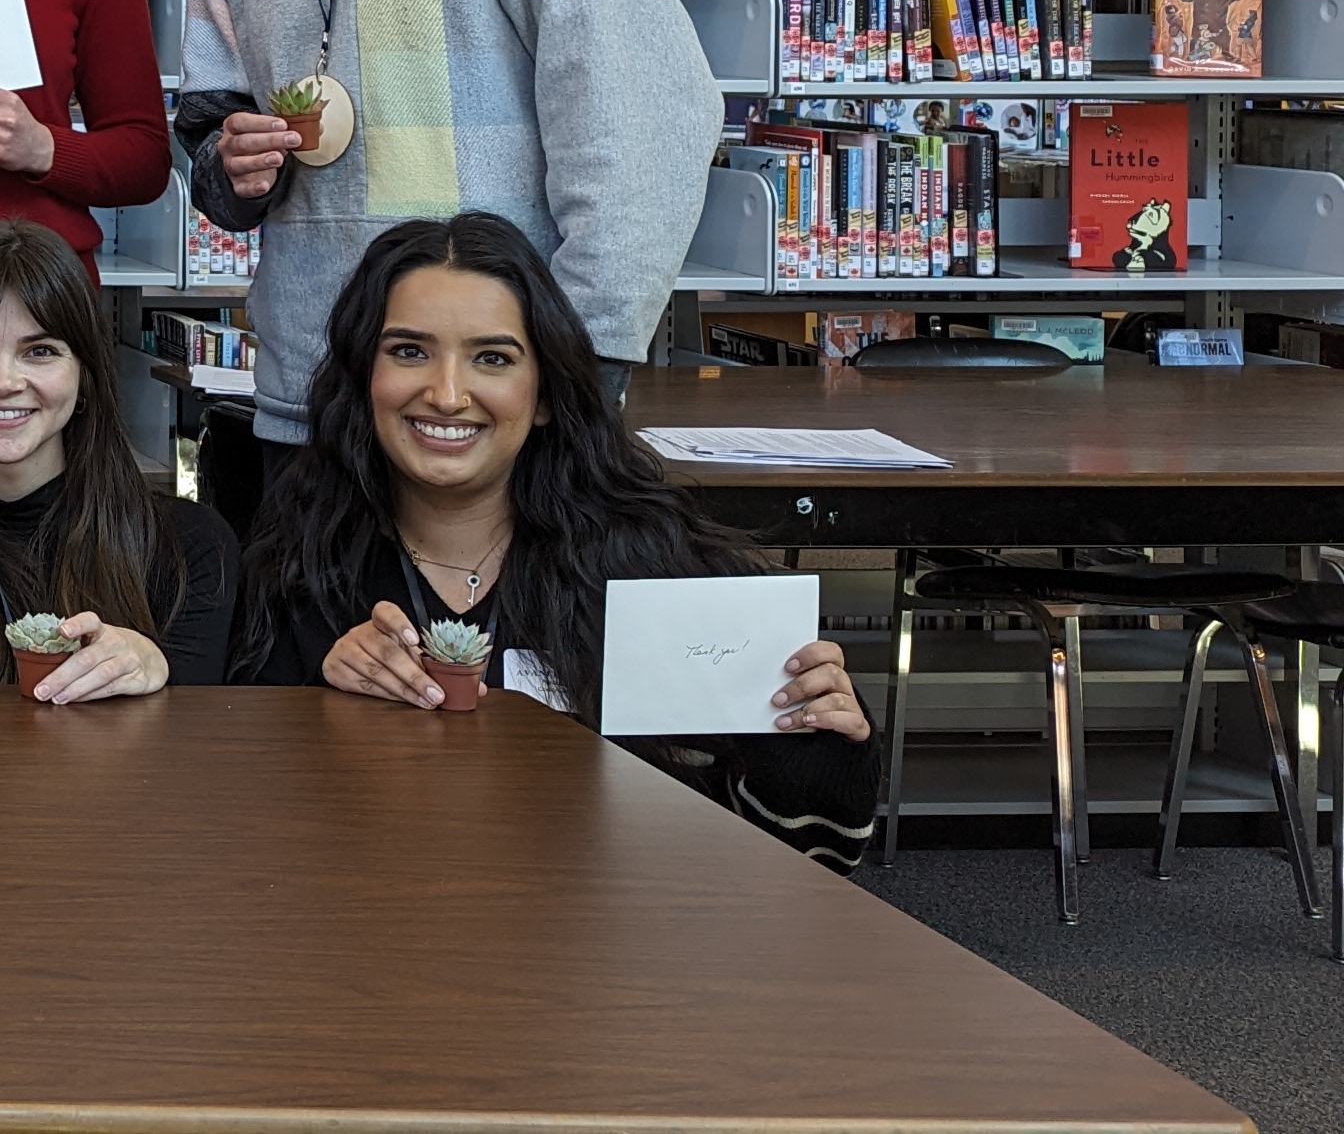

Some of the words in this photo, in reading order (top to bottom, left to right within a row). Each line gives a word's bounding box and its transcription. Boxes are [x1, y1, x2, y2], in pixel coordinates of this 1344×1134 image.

[900, 159, 912, 174] THE
[1091, 148, 1160, 168] Little
[887, 161, 896, 177] THE
[1105, 173, 1175, 184] Hummingbird
[887, 178, 896, 205] BREAK
[900, 176, 912, 204] BREAK
[933, 173, 942, 210] INDIAN
[686, 643, 715, 659] Thank
